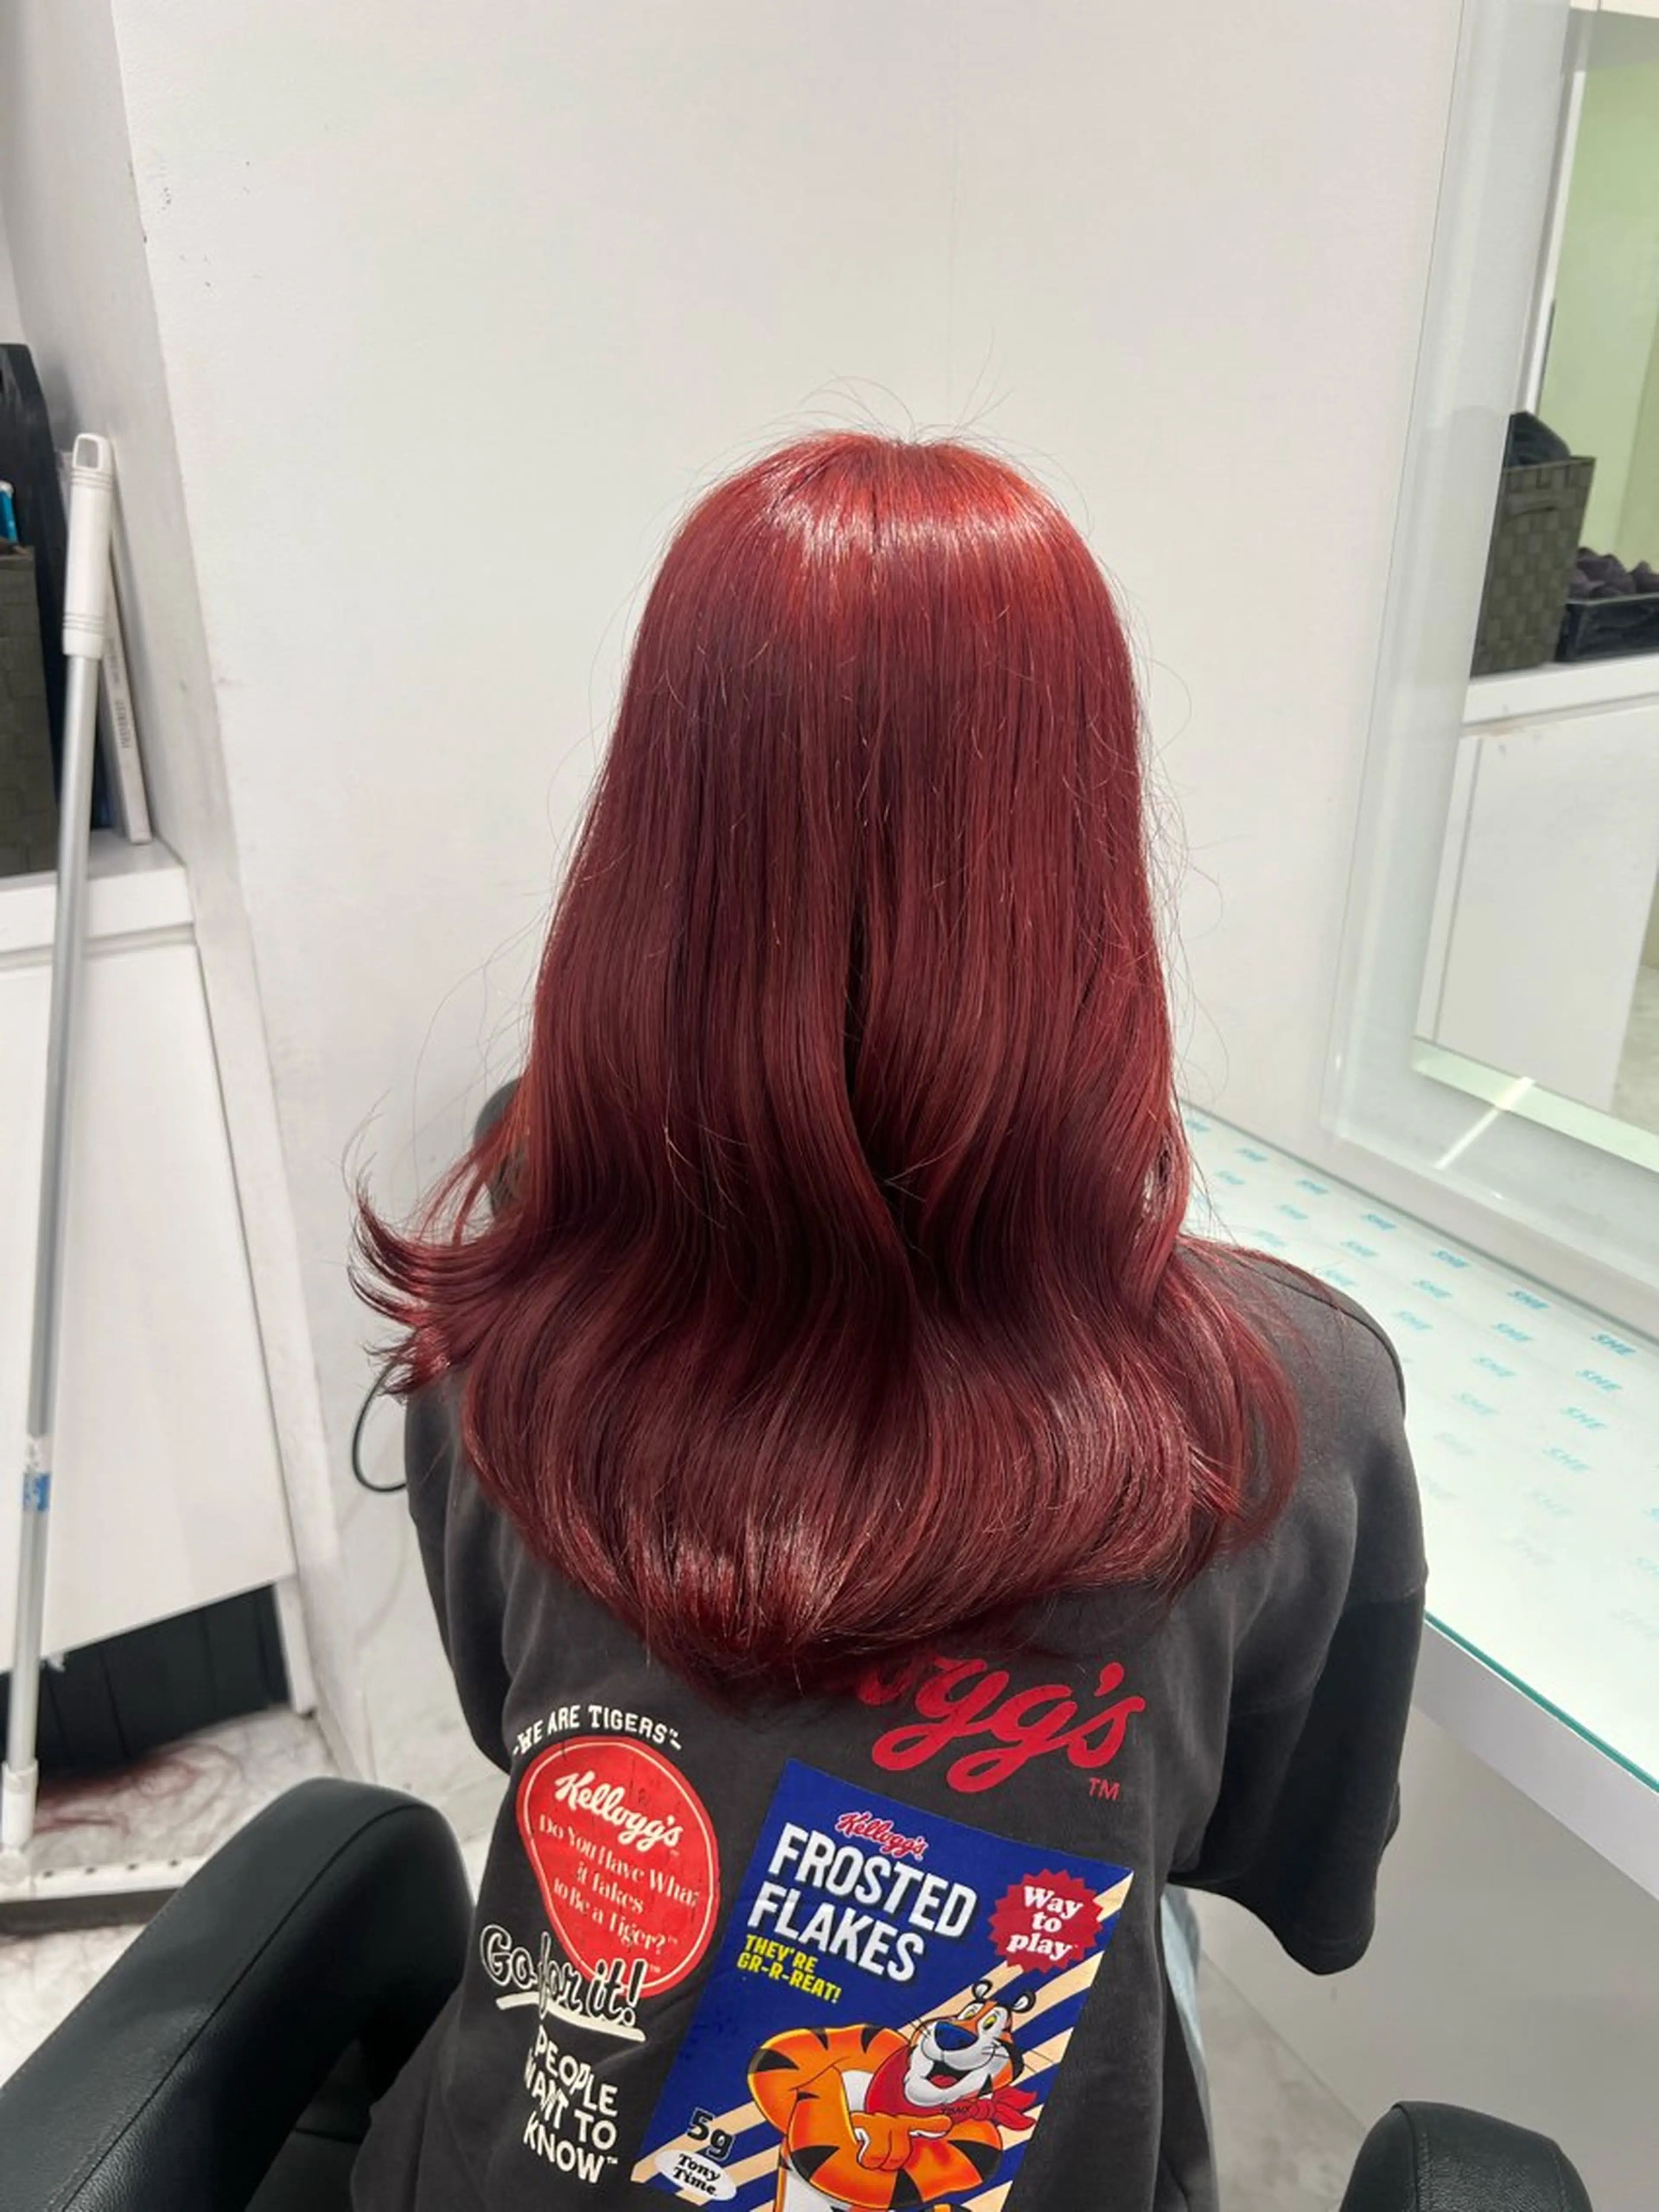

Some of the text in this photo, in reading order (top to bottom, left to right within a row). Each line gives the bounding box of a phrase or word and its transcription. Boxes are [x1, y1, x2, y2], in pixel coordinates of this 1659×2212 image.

[547, 1705, 581, 1735] ARE
[554, 1770, 684, 1852] Kellogg's
[834, 1811, 929, 1859] Kellogg's
[540, 1814, 565, 1840] Do
[567, 1826, 596, 1859] You
[598, 1846, 645, 1882] Have
[576, 1861, 644, 1915] it Takes
[768, 1822, 978, 1938] FROSTED
[1024, 1885, 1083, 1920] Way
[569, 1887, 590, 1914] Be
[592, 1907, 604, 1925] a
[1031, 1911, 1063, 1932] to
[746, 1934, 819, 1974] THEY'RE
[747, 1881, 925, 1982] FLAKES
[1006, 1933, 1073, 1961] play
[480, 1924, 538, 1989] Go
[536, 1931, 583, 2019] for
[587, 1958, 648, 2027] it!
[736, 1952, 842, 2005] GR-R-REAT!
[534, 2024, 618, 2117] PEOPLE
[524, 2047, 617, 2150] WANT TO
[672, 2166, 717, 2197] Time
[678, 2153, 721, 2182] Tony
